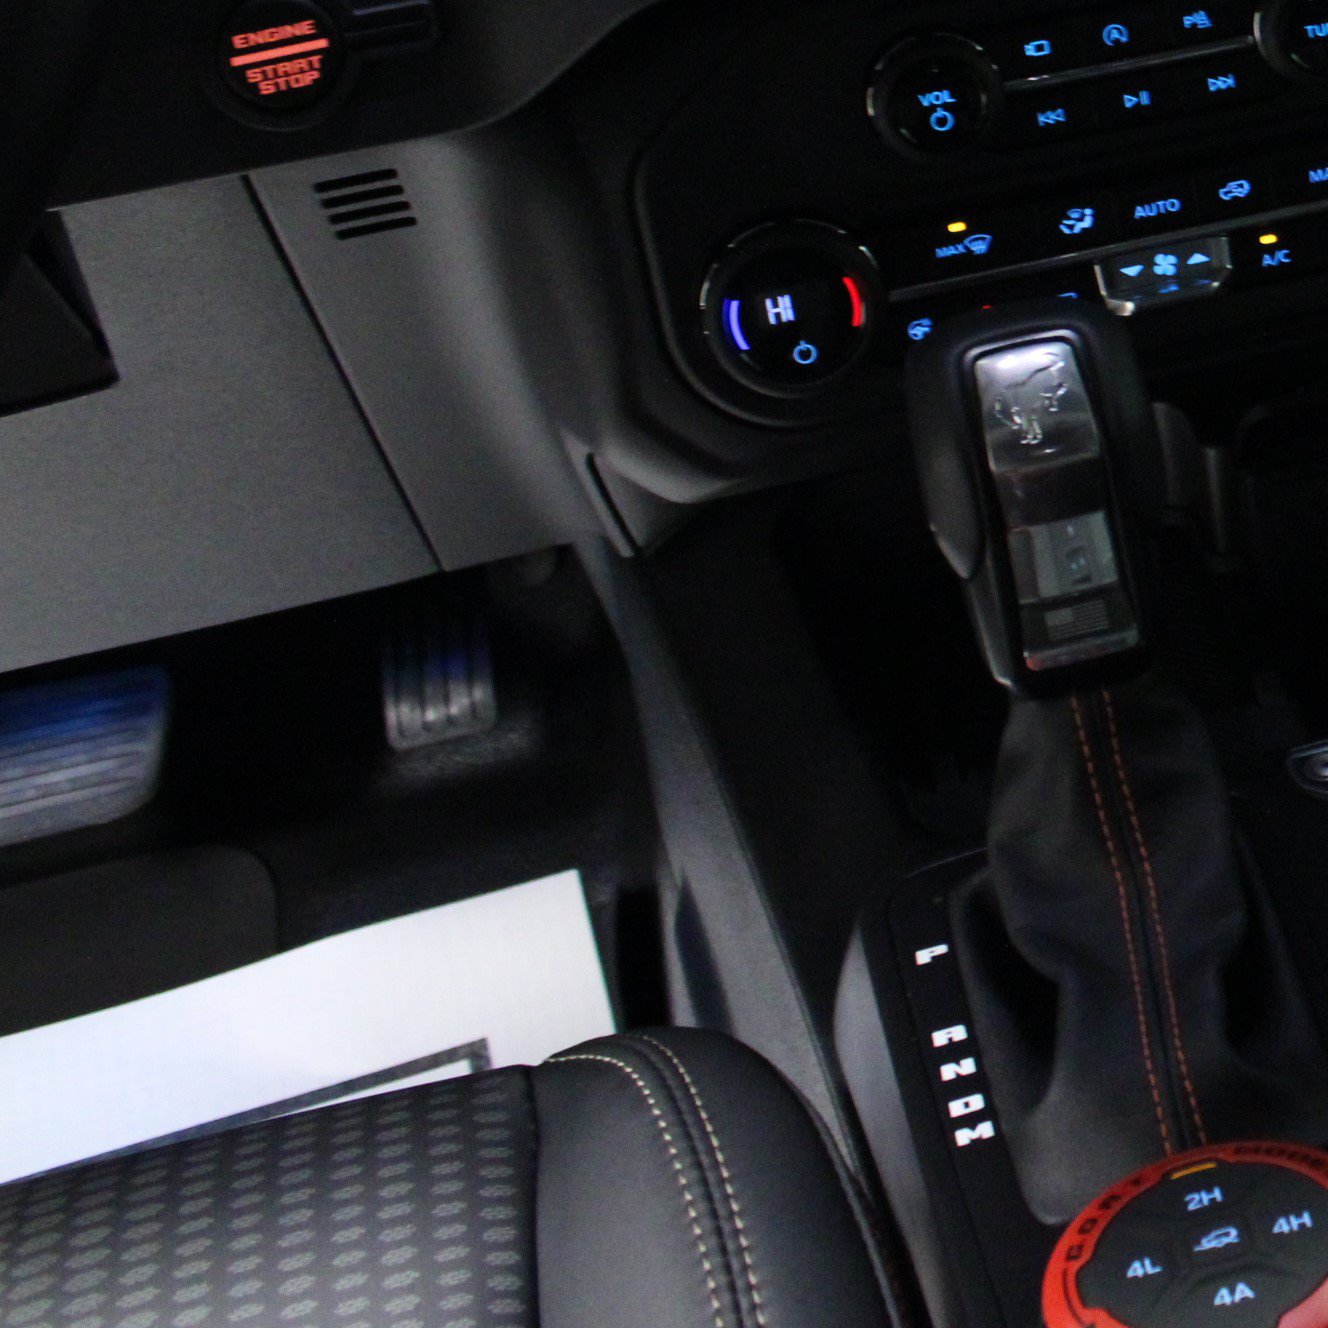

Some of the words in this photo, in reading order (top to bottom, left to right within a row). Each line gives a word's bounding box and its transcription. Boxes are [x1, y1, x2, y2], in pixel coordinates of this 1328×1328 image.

[230, 19, 317, 49] ENGINE
[245, 54, 324, 84] START
[257, 70, 321, 96] STOP
[917, 88, 957, 108] VOL
[1133, 197, 1182, 220] AUTO
[934, 241, 967, 259] MAX
[1261, 248, 1292, 268] A/C
[764, 293, 796, 325] HI
[915, 943, 949, 966] P
[931, 1024, 968, 1048] A
[939, 1056, 977, 1082] N
[948, 1092, 986, 1119] D
[954, 1120, 996, 1147] M
[1184, 1185, 1224, 1212] 2H
[1271, 1210, 1313, 1236] 4H
[1126, 1256, 1164, 1279] 4L
[1212, 1281, 1256, 1307] 4A
